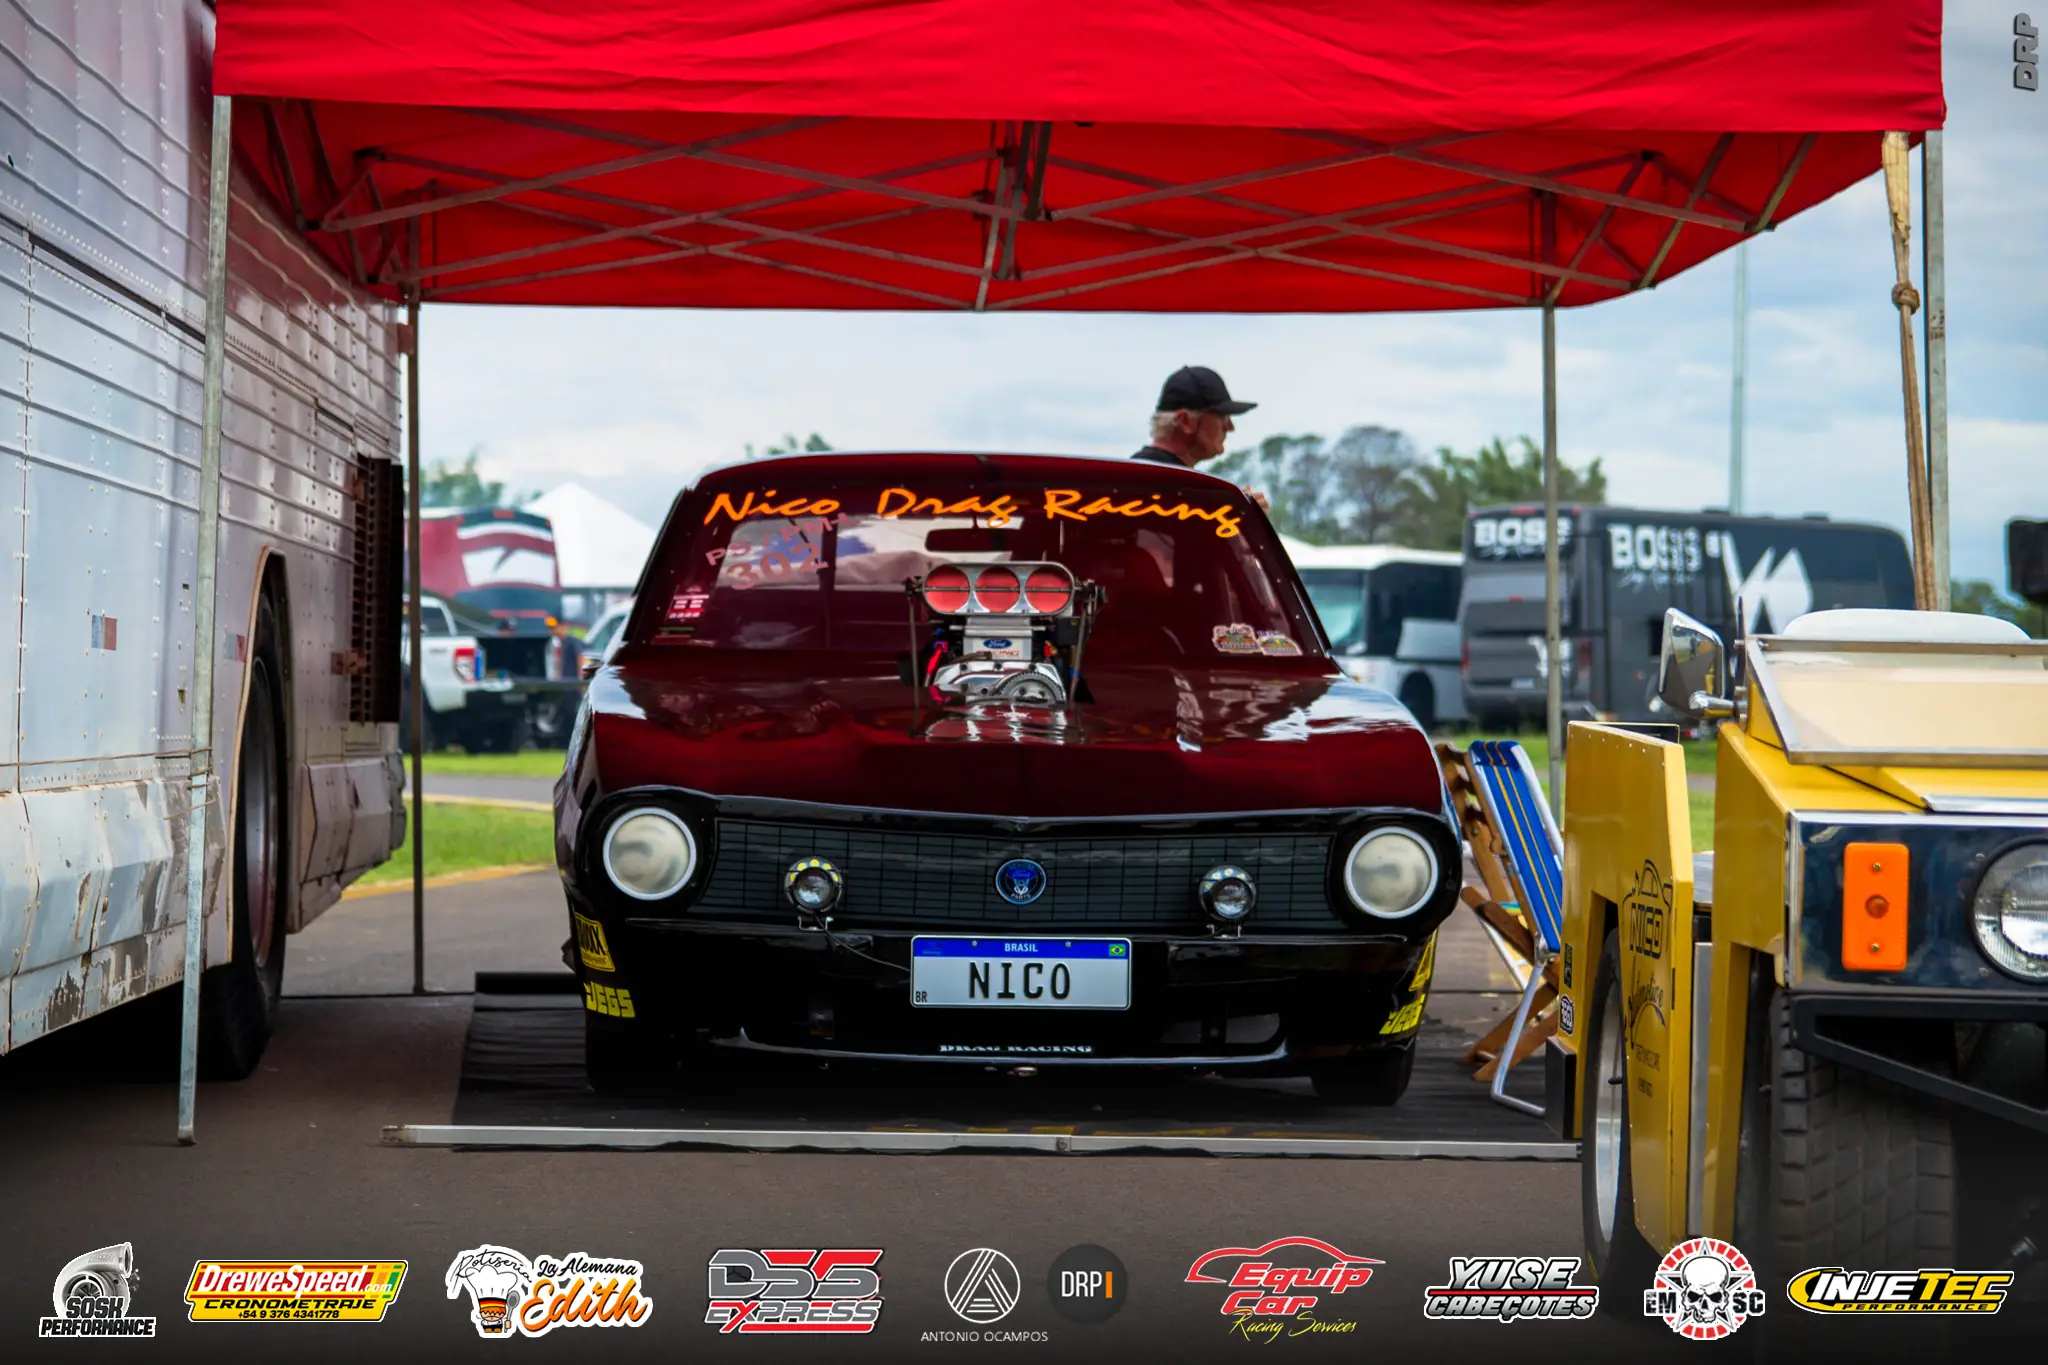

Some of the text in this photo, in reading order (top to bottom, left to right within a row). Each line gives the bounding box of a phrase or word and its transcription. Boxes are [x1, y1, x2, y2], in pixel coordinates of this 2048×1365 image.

[704, 488, 1241, 537] Nico Drag Racing
[727, 542, 829, 591] 302
[1004, 943, 1039, 953] BRASIL
[583, 981, 636, 1018] JEGS
[915, 991, 928, 1003] BR
[969, 962, 1071, 1000] NICO
[1007, 1045, 1092, 1053] RACING
